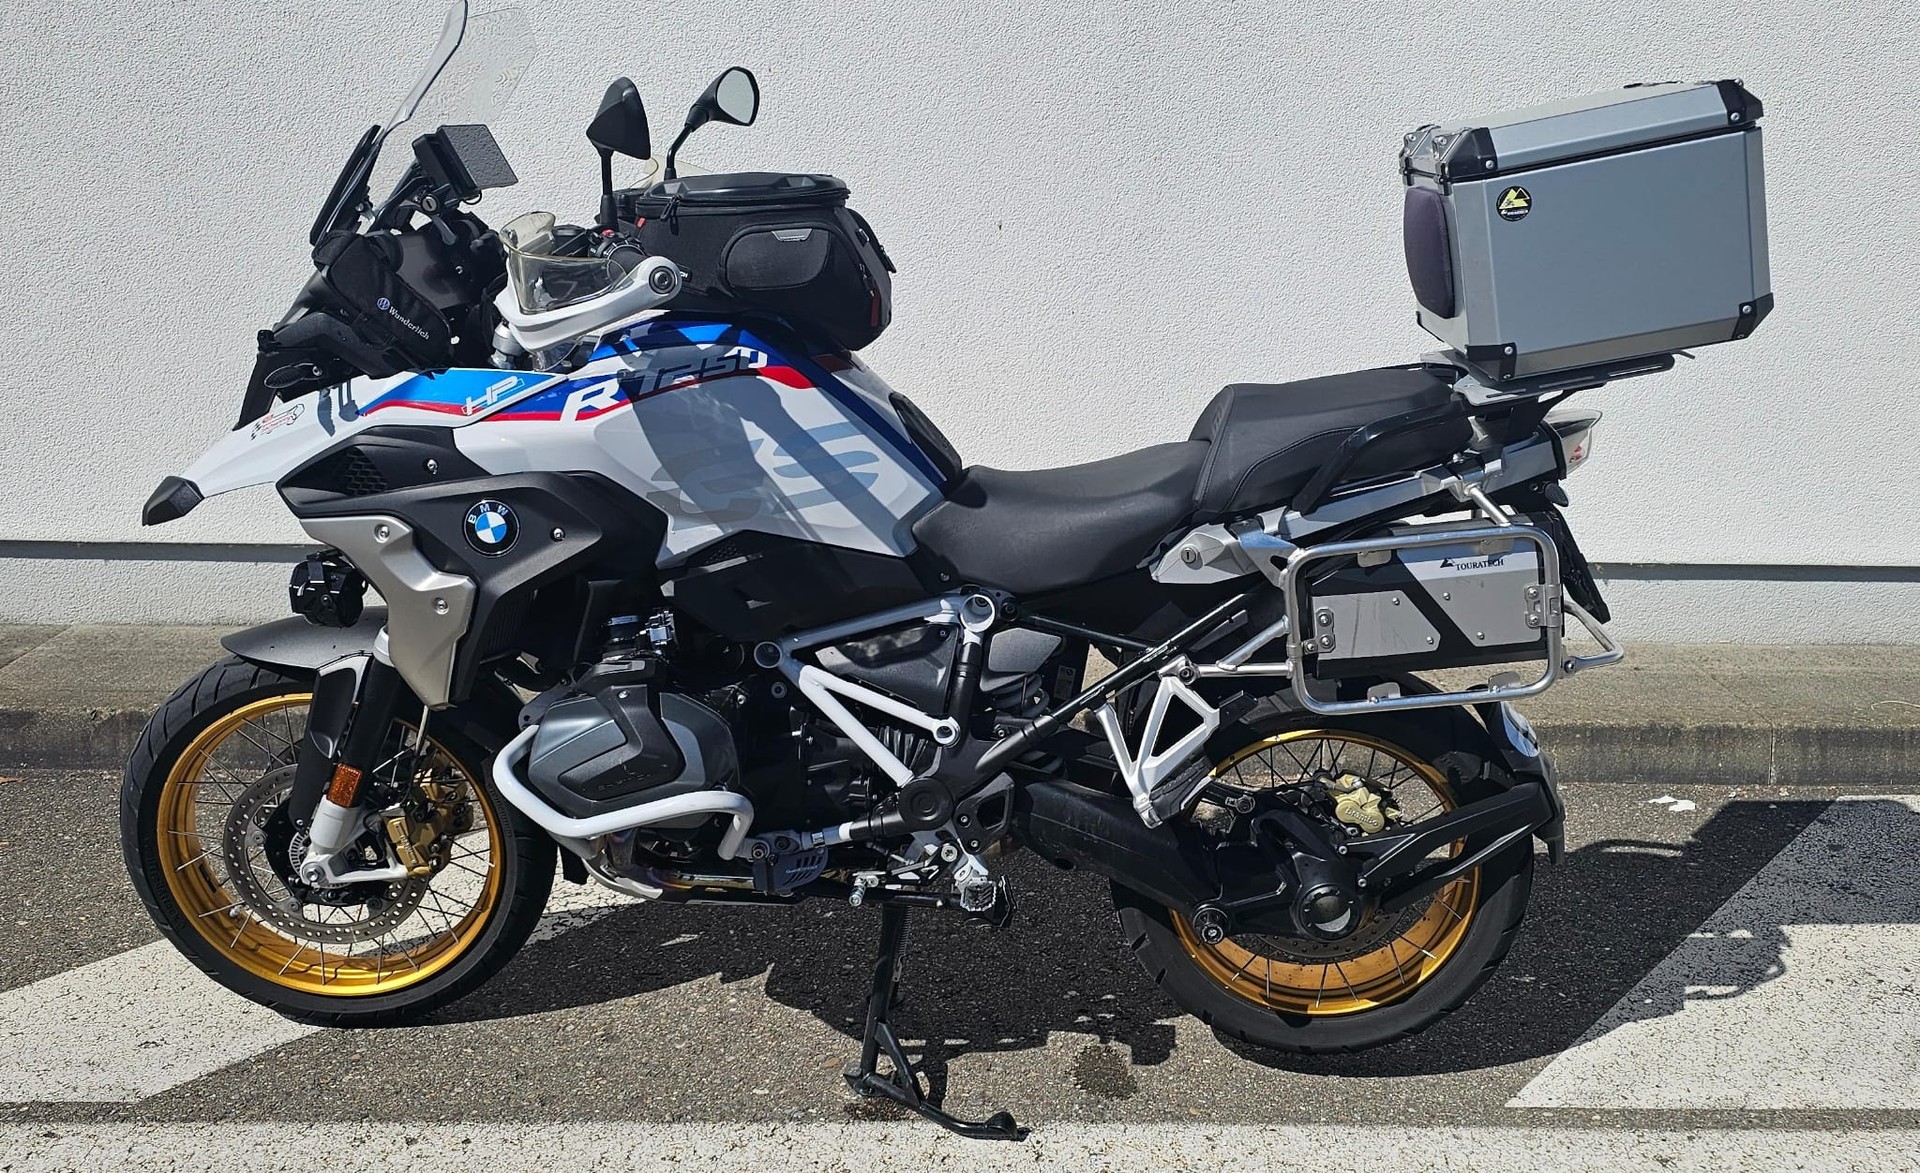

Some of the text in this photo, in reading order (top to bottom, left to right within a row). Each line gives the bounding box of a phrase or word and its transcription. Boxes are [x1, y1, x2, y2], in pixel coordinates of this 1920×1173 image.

[388, 306, 430, 340] Wunderlich
[463, 376, 520, 415] HP
[560, 375, 620, 421] R
[467, 503, 509, 524] BMW
[1456, 558, 1504, 571] TOURATECH
